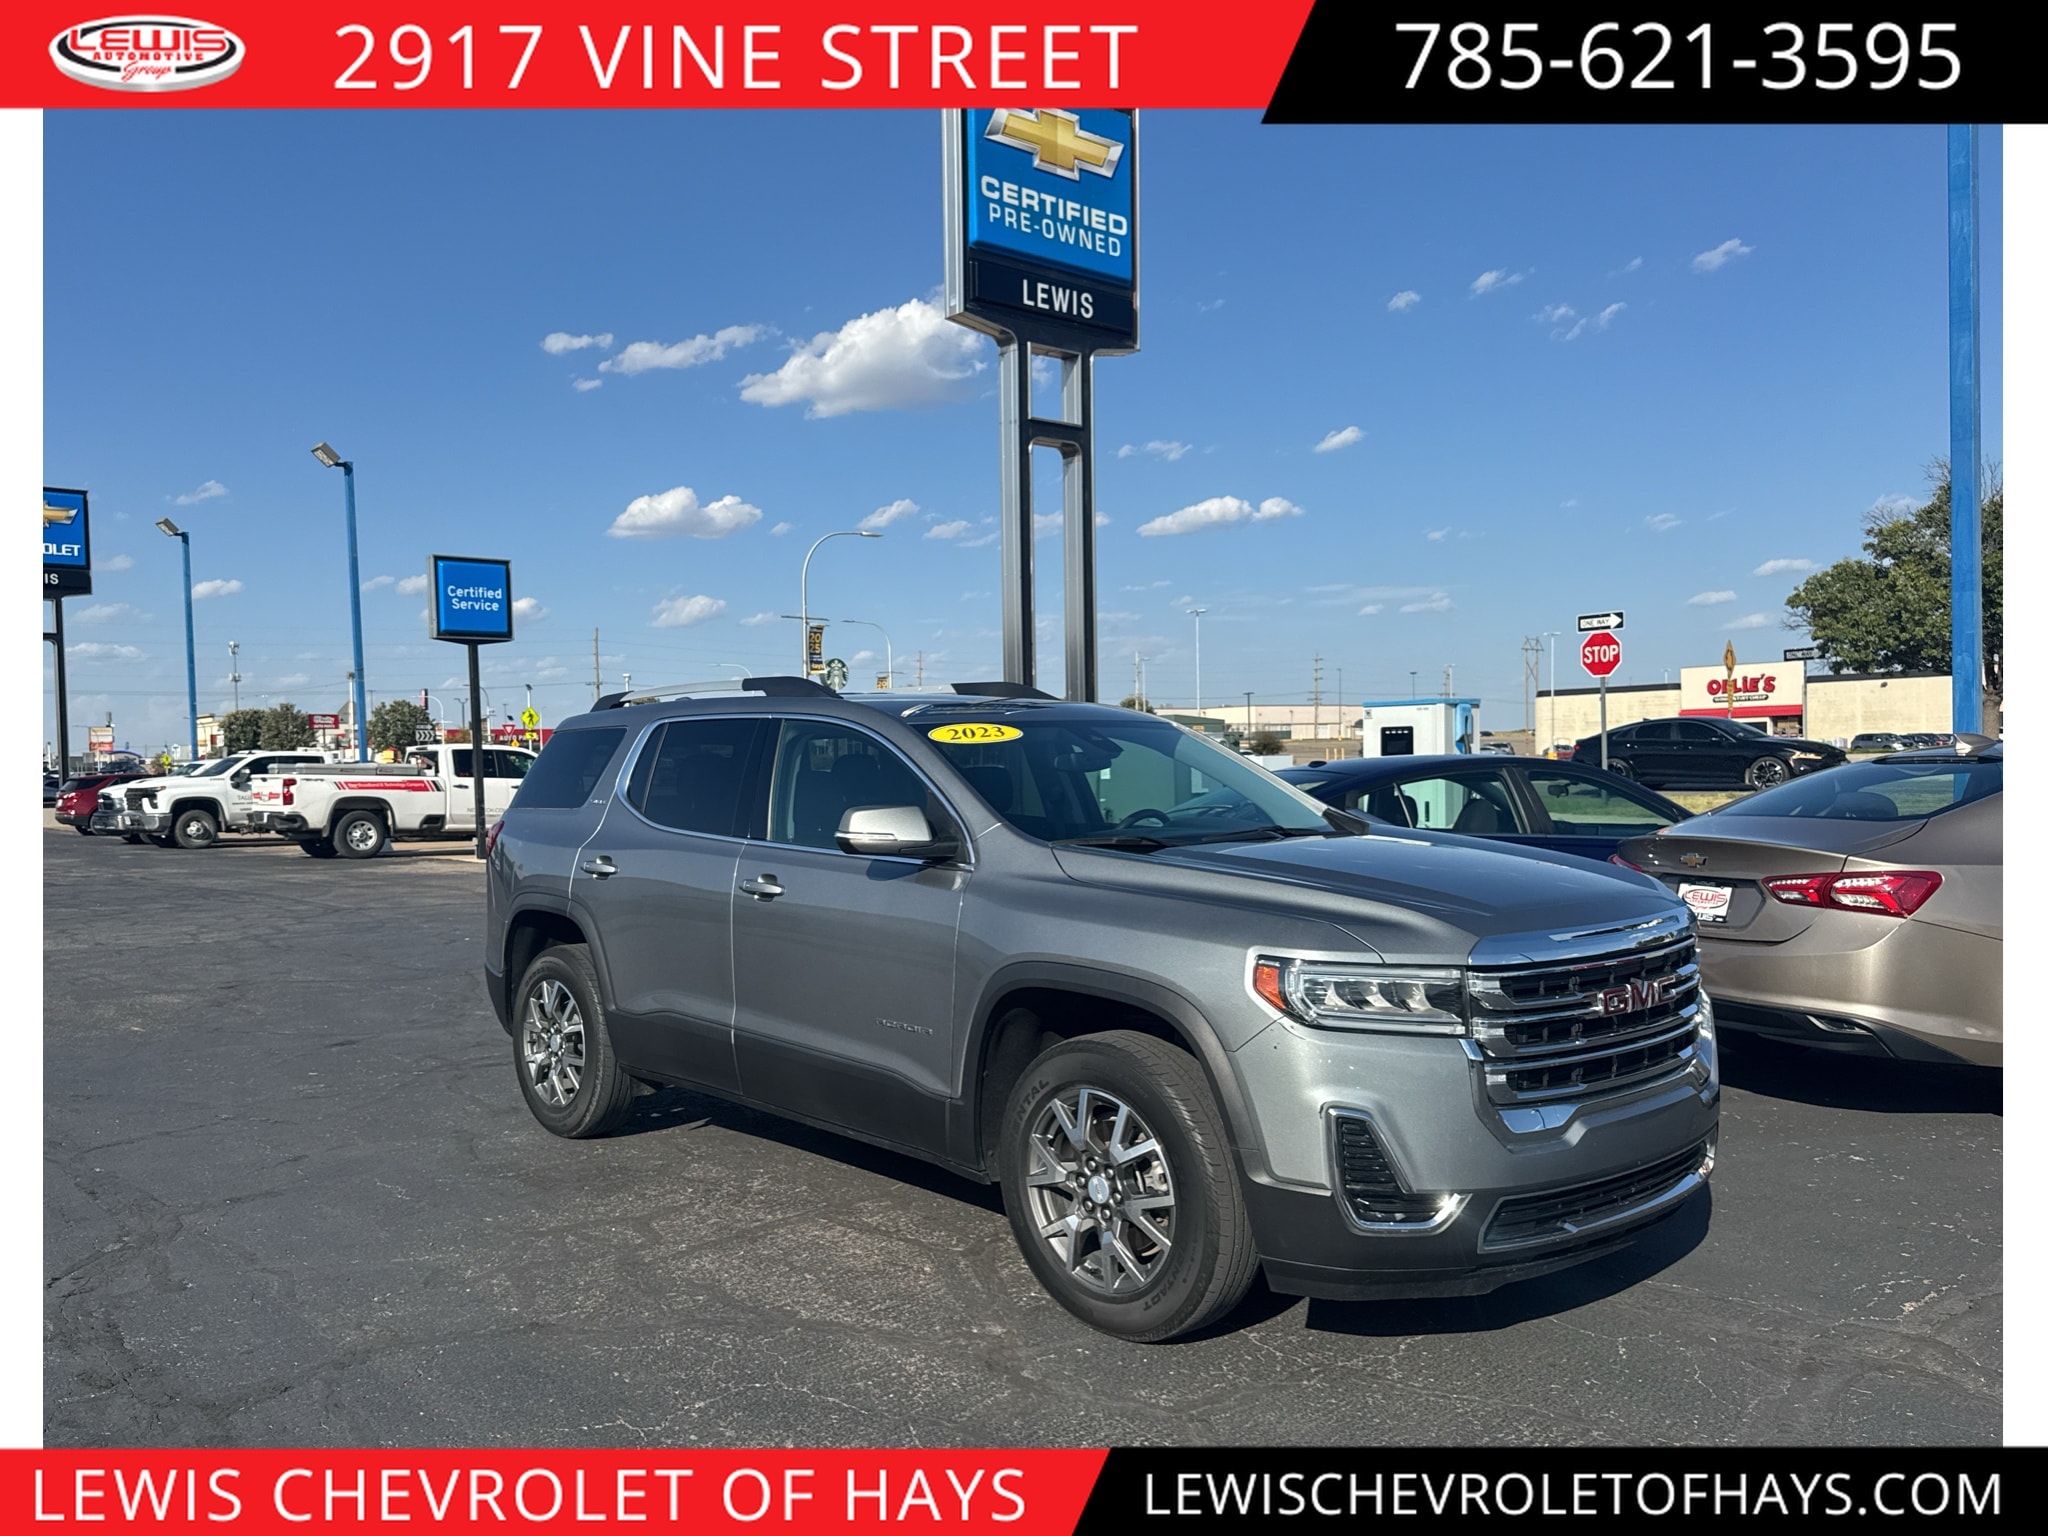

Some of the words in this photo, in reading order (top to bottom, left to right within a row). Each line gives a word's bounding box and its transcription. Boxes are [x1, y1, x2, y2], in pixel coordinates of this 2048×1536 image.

[981, 175, 1128, 236] CERTIFIED
[988, 203, 1121, 257] PRE-OWNED
[1022, 279, 1094, 319] LEWIS
[447, 585, 502, 599] Certified
[452, 598, 500, 611] Service
[1583, 644, 1619, 664] STOP
[1707, 673, 1776, 696] OLLIE'S
[947, 726, 1005, 741] 2023
[1684, 891, 1727, 903] LEWIS
[1599, 975, 1676, 1016] GMC
